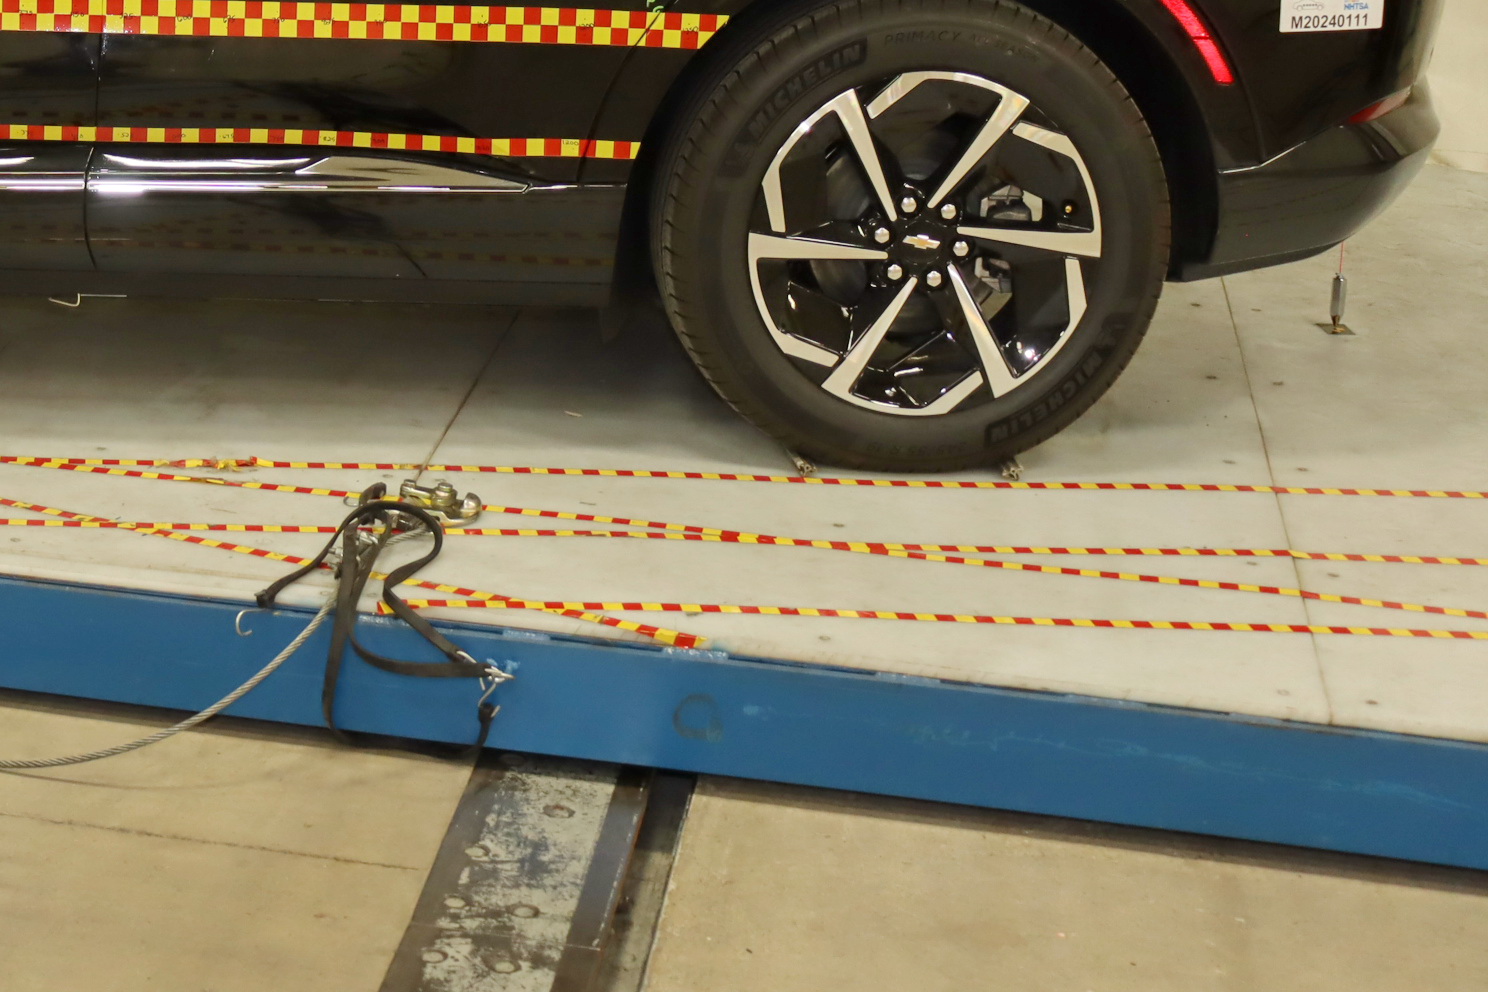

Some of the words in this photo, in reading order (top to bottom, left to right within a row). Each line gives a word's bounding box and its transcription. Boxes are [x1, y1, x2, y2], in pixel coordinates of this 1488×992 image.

[1291, 13, 1369, 29] M20240111
[1343, 2, 1369, 11] NHTSA
[748, 43, 862, 137] MICHELIN
[990, 351, 1103, 443] MICHELIN
